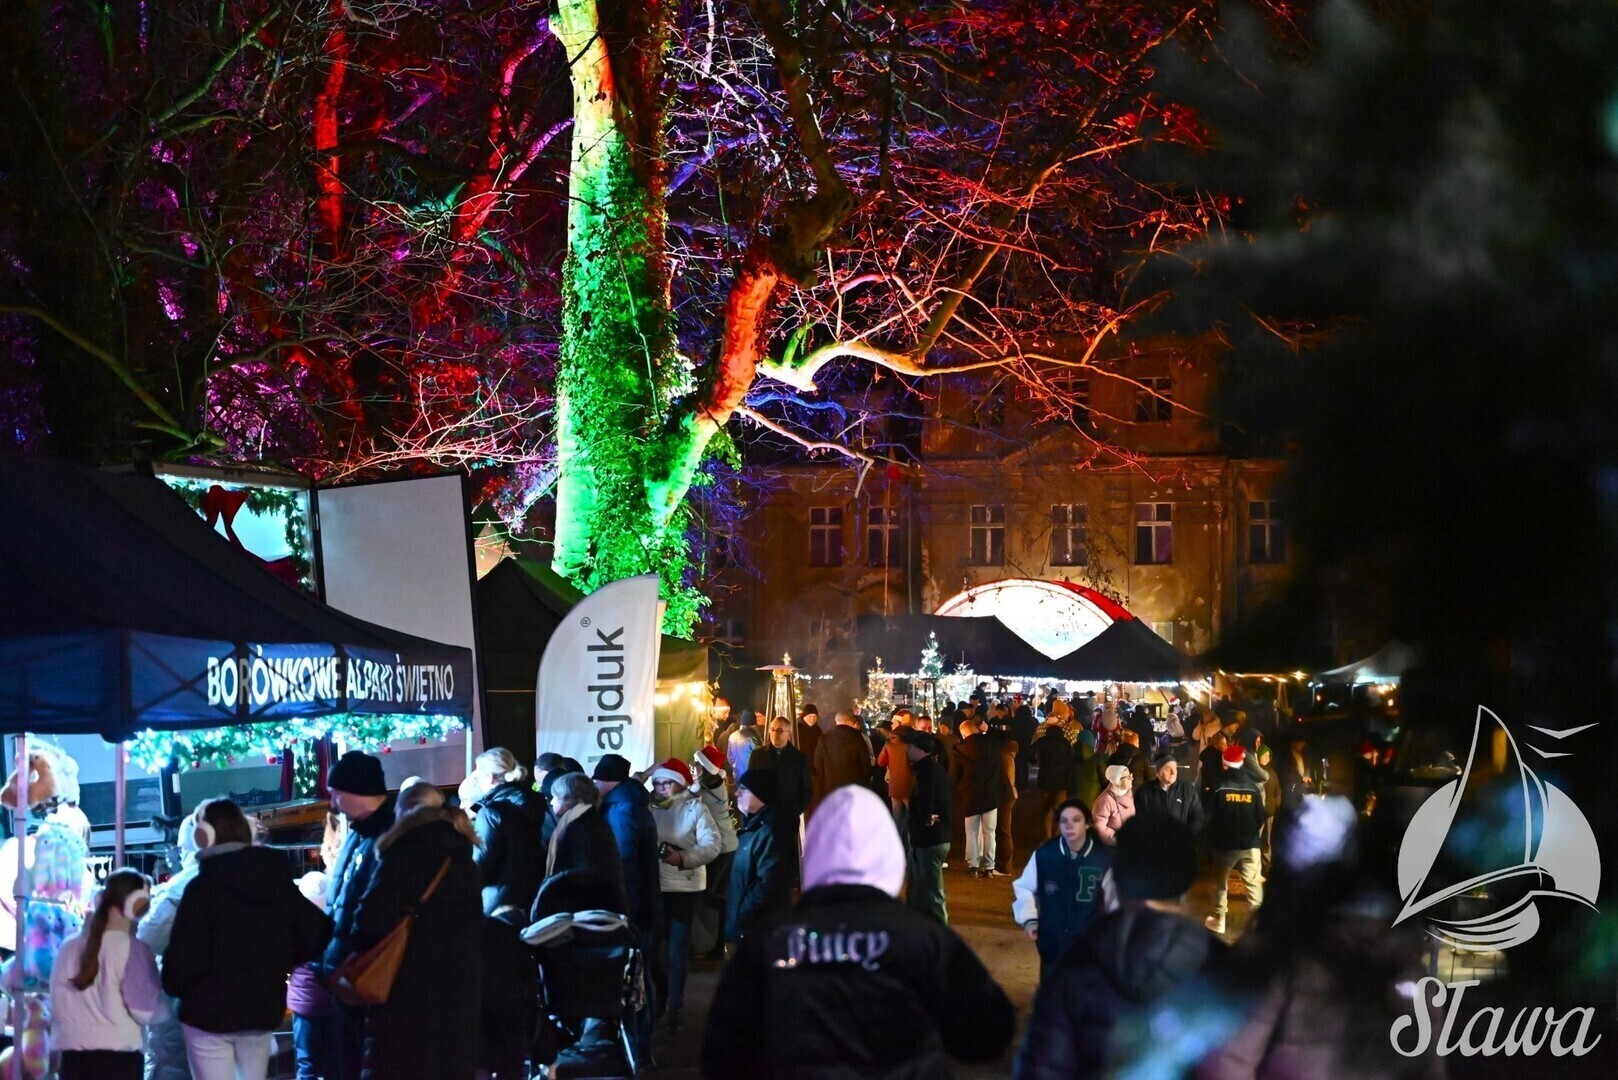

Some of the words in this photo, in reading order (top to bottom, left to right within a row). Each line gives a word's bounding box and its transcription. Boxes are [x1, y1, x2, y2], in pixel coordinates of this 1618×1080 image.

[207, 644, 341, 707] BORÓWKOWE
[346, 658, 394, 702] ALPAKI
[395, 653, 454, 711] ŚWIĘTNO
[587, 626, 632, 763] ajduk
[1076, 866, 1103, 902] F
